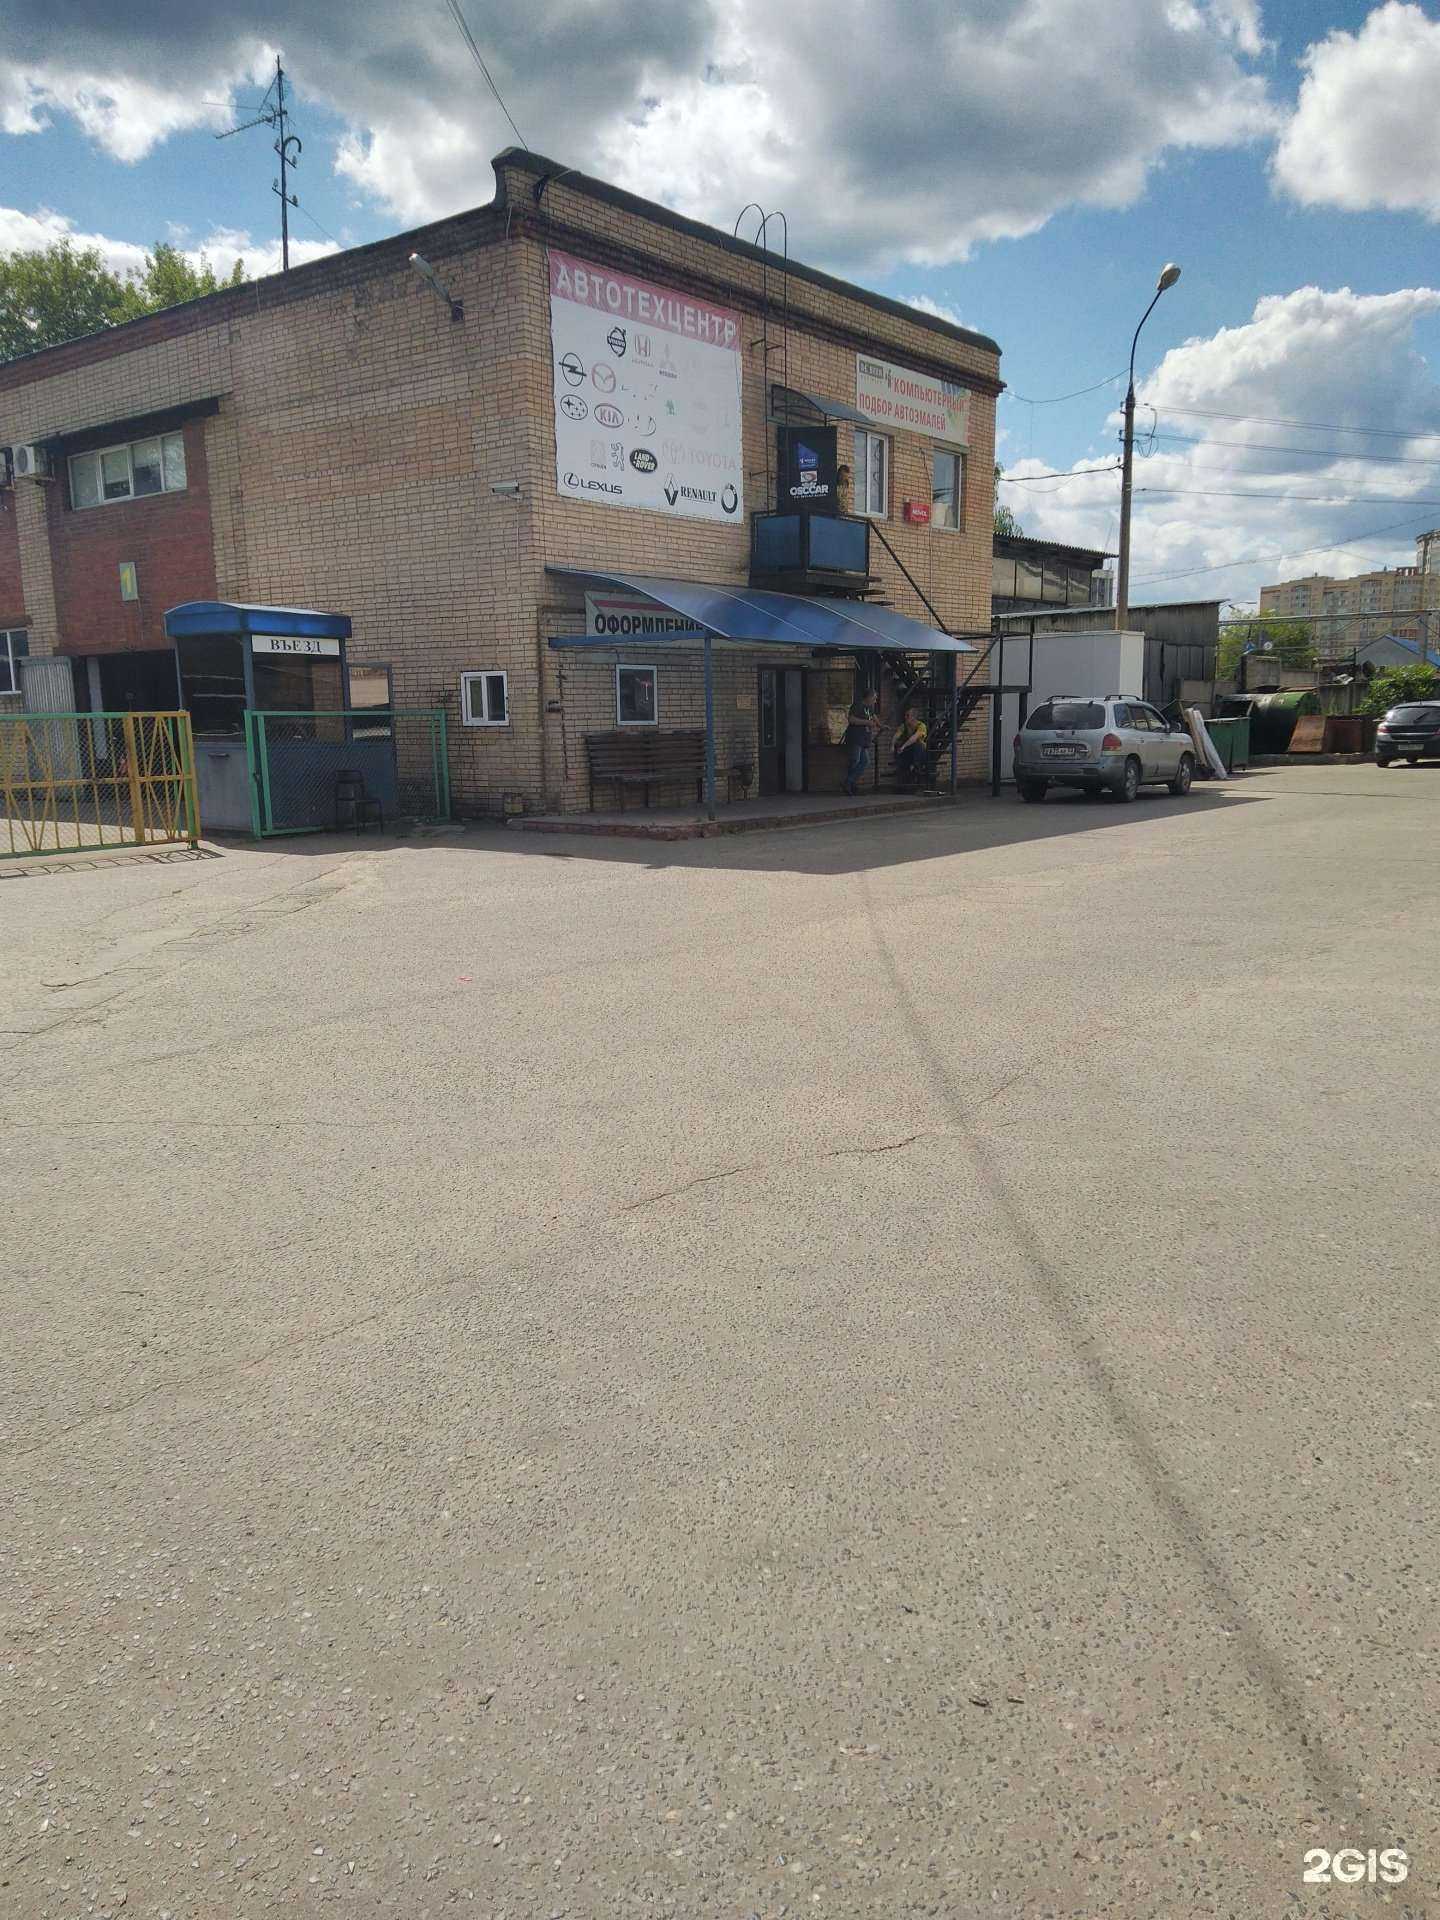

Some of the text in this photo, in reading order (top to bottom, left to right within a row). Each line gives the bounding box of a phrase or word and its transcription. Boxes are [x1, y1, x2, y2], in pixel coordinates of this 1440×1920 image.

[556, 263, 737, 341] АВТОТЕХЦЕНТР
[600, 408, 619, 424] KIA
[860, 392, 946, 431] ПОДБОР АВТОЭМАЛЕЙ
[634, 451, 650, 460] LAND
[690, 451, 736, 470] TOYOTA
[635, 459, 656, 470] ROVER
[580, 478, 623, 495] LEXUS
[680, 486, 717, 502] RENAULT
[270, 639, 321, 653] ВЪЕЗД
